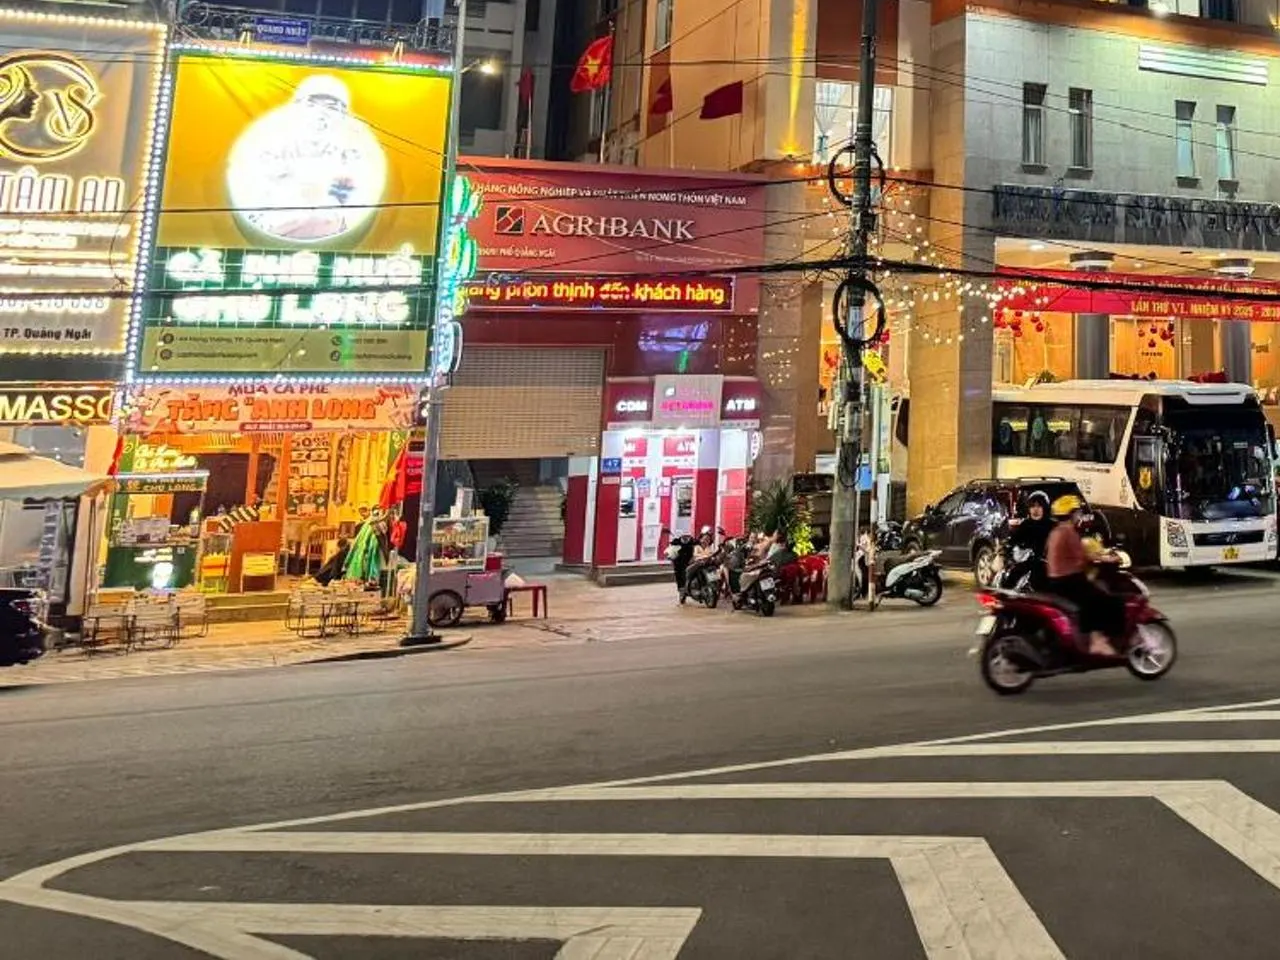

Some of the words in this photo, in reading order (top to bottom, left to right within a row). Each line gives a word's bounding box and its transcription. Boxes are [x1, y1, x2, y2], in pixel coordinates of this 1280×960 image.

[531, 213, 695, 239] AGRIBANK
[553, 282, 594, 301] thịnh
[634, 282, 681, 301] khách
[685, 284, 725, 304] hàng
[4, 328, 20, 338] TP.
[24, 326, 62, 340] Quảng
[725, 398, 756, 411] ATM
